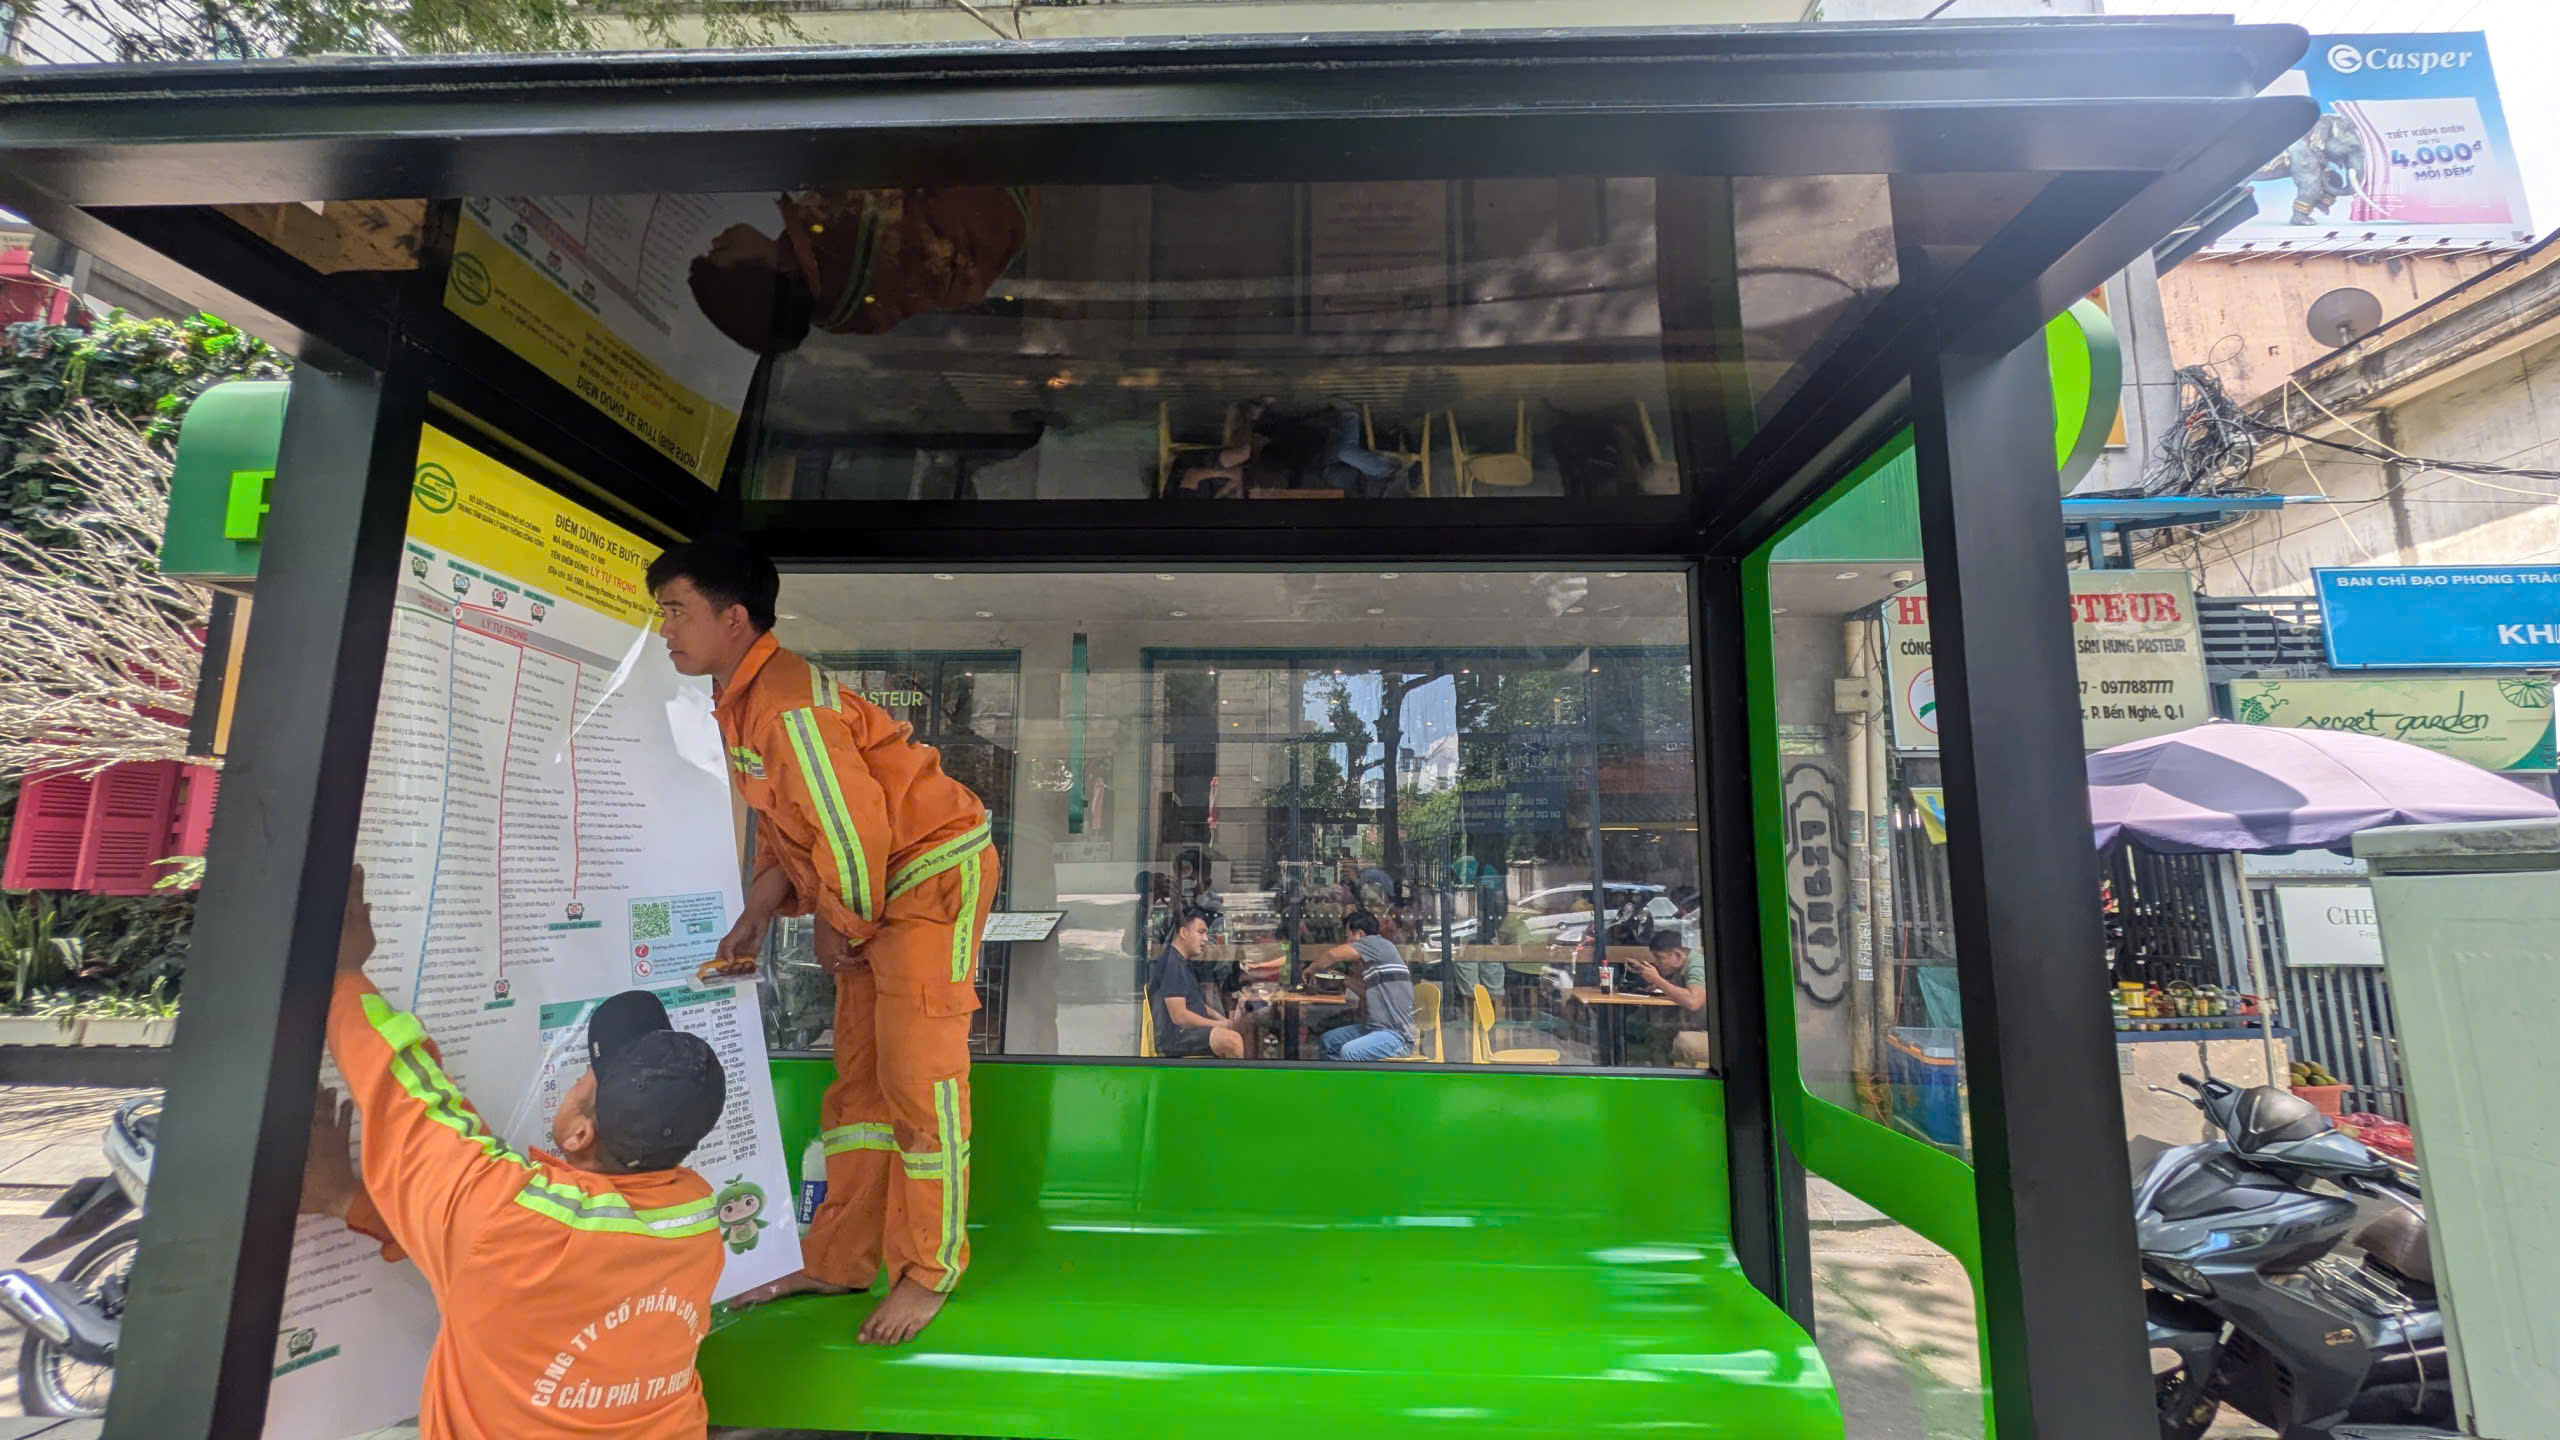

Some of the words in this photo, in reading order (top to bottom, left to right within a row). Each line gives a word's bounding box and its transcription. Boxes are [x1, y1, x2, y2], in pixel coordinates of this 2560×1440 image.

[2366, 47, 2473, 75] Casper
[606, 539, 618, 556] XE
[2336, 575, 2373, 588] BAN
[2411, 574, 2448, 588] ĐẠO
[2452, 574, 2514, 585] PHONG
[2138, 638, 2186, 653] PASTEUR
[2101, 679, 2174, 694] 0977887777
[2103, 703, 2125, 719] Bến
[2300, 708, 2404, 732] secret
[2395, 690, 2489, 741] garden
[544, 1080, 556, 1092] 36
[544, 1096, 557, 1109] 52
[803, 1184, 815, 1221] PEPSI
[531, 1352, 575, 1407] CÔNG
[570, 1322, 598, 1352] TY
[604, 1377, 640, 1409] PHÀ
